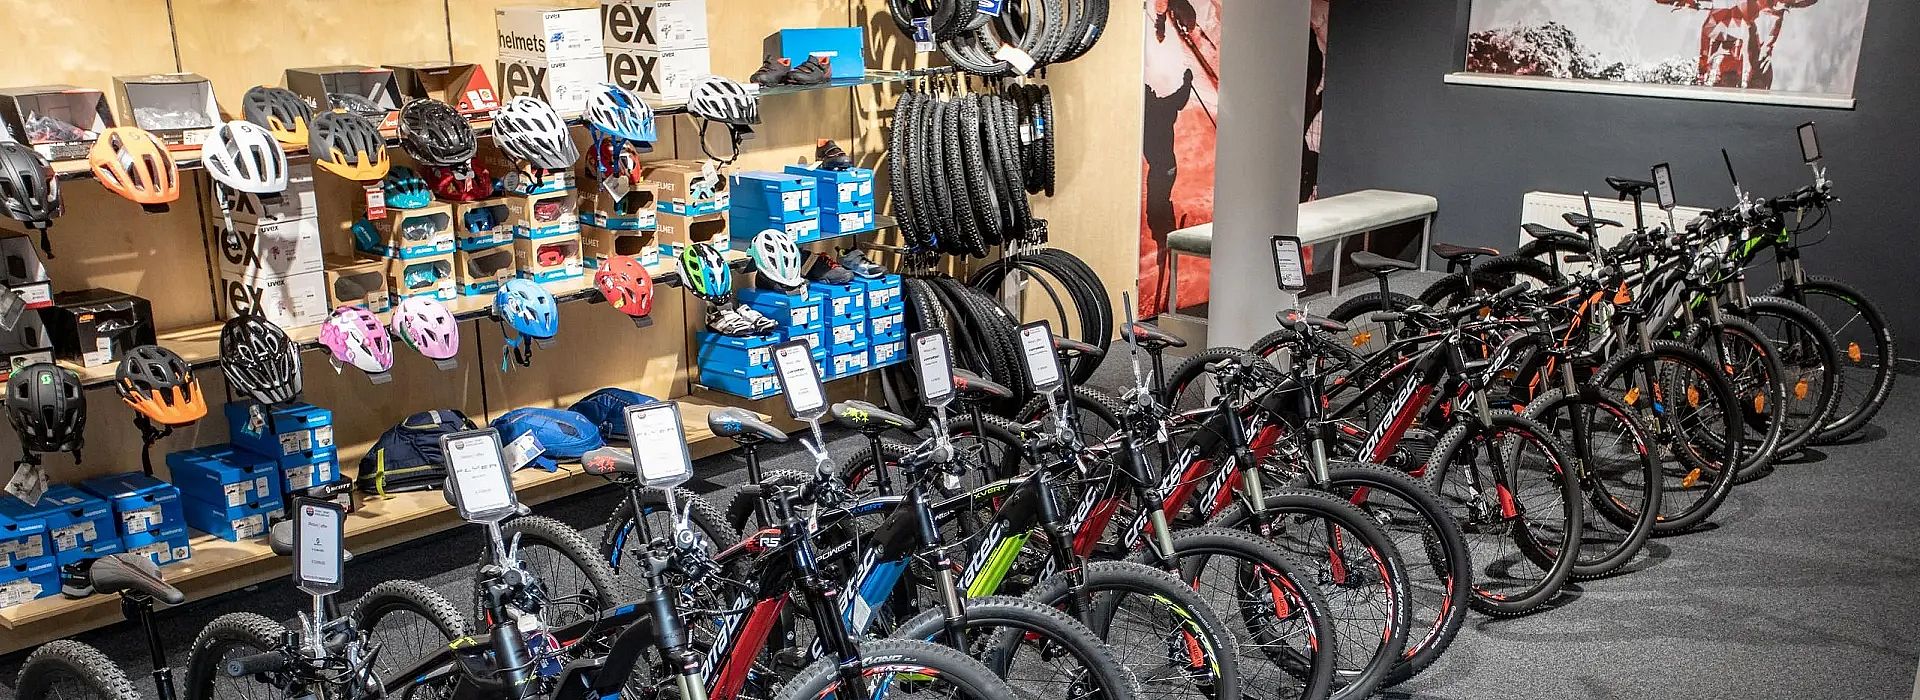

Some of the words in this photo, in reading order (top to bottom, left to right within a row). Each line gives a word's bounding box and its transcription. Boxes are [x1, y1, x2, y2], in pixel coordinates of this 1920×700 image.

[498, 28, 546, 53] helmets
[267, 280, 285, 288] uvex
[1358, 374, 1418, 463] corratec
[815, 540, 853, 563] POWER
